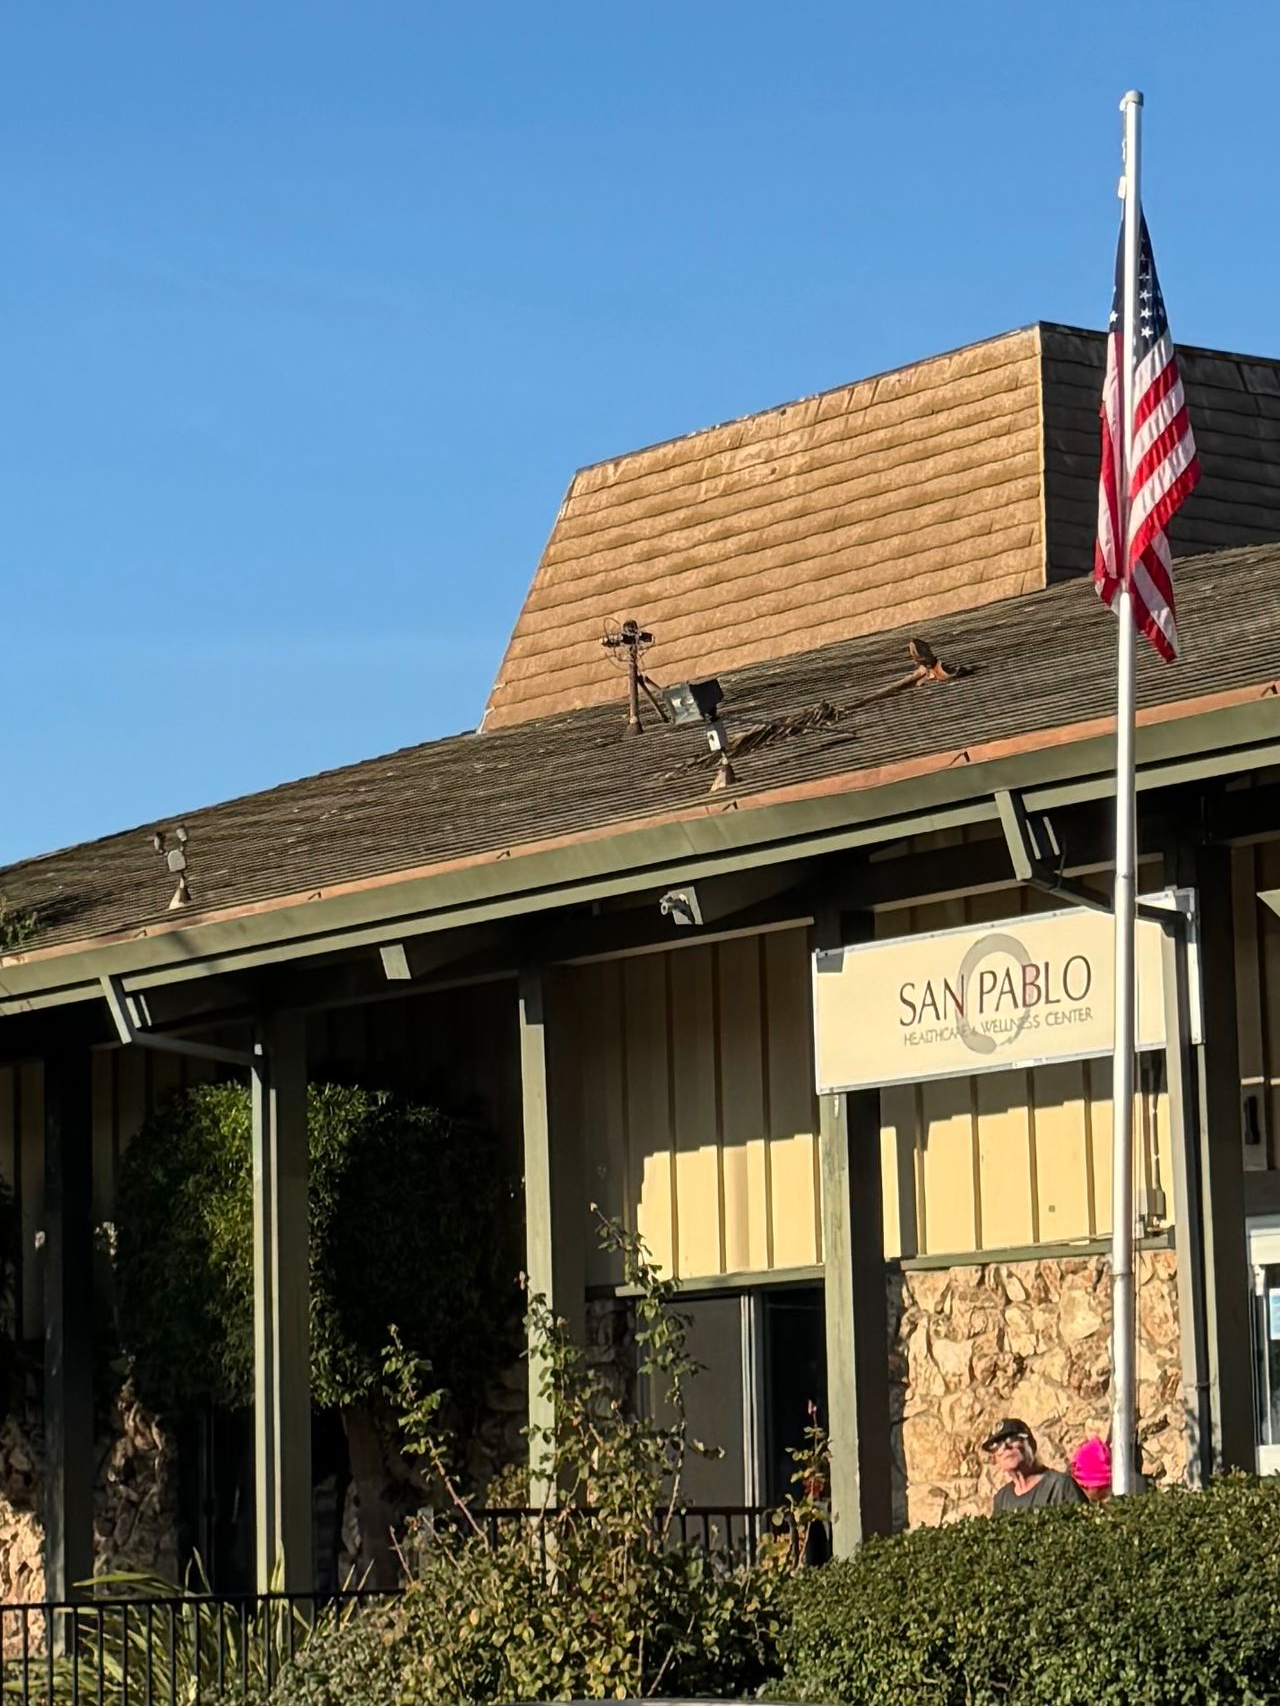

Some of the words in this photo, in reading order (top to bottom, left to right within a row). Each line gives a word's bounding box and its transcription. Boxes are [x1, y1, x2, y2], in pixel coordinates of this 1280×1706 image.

[899, 973, 965, 1027] SAN
[979, 954, 1092, 1014] PABLO
[980, 1014, 1041, 1035] WELLNESS
[1044, 1006, 1094, 1028] CENTER
